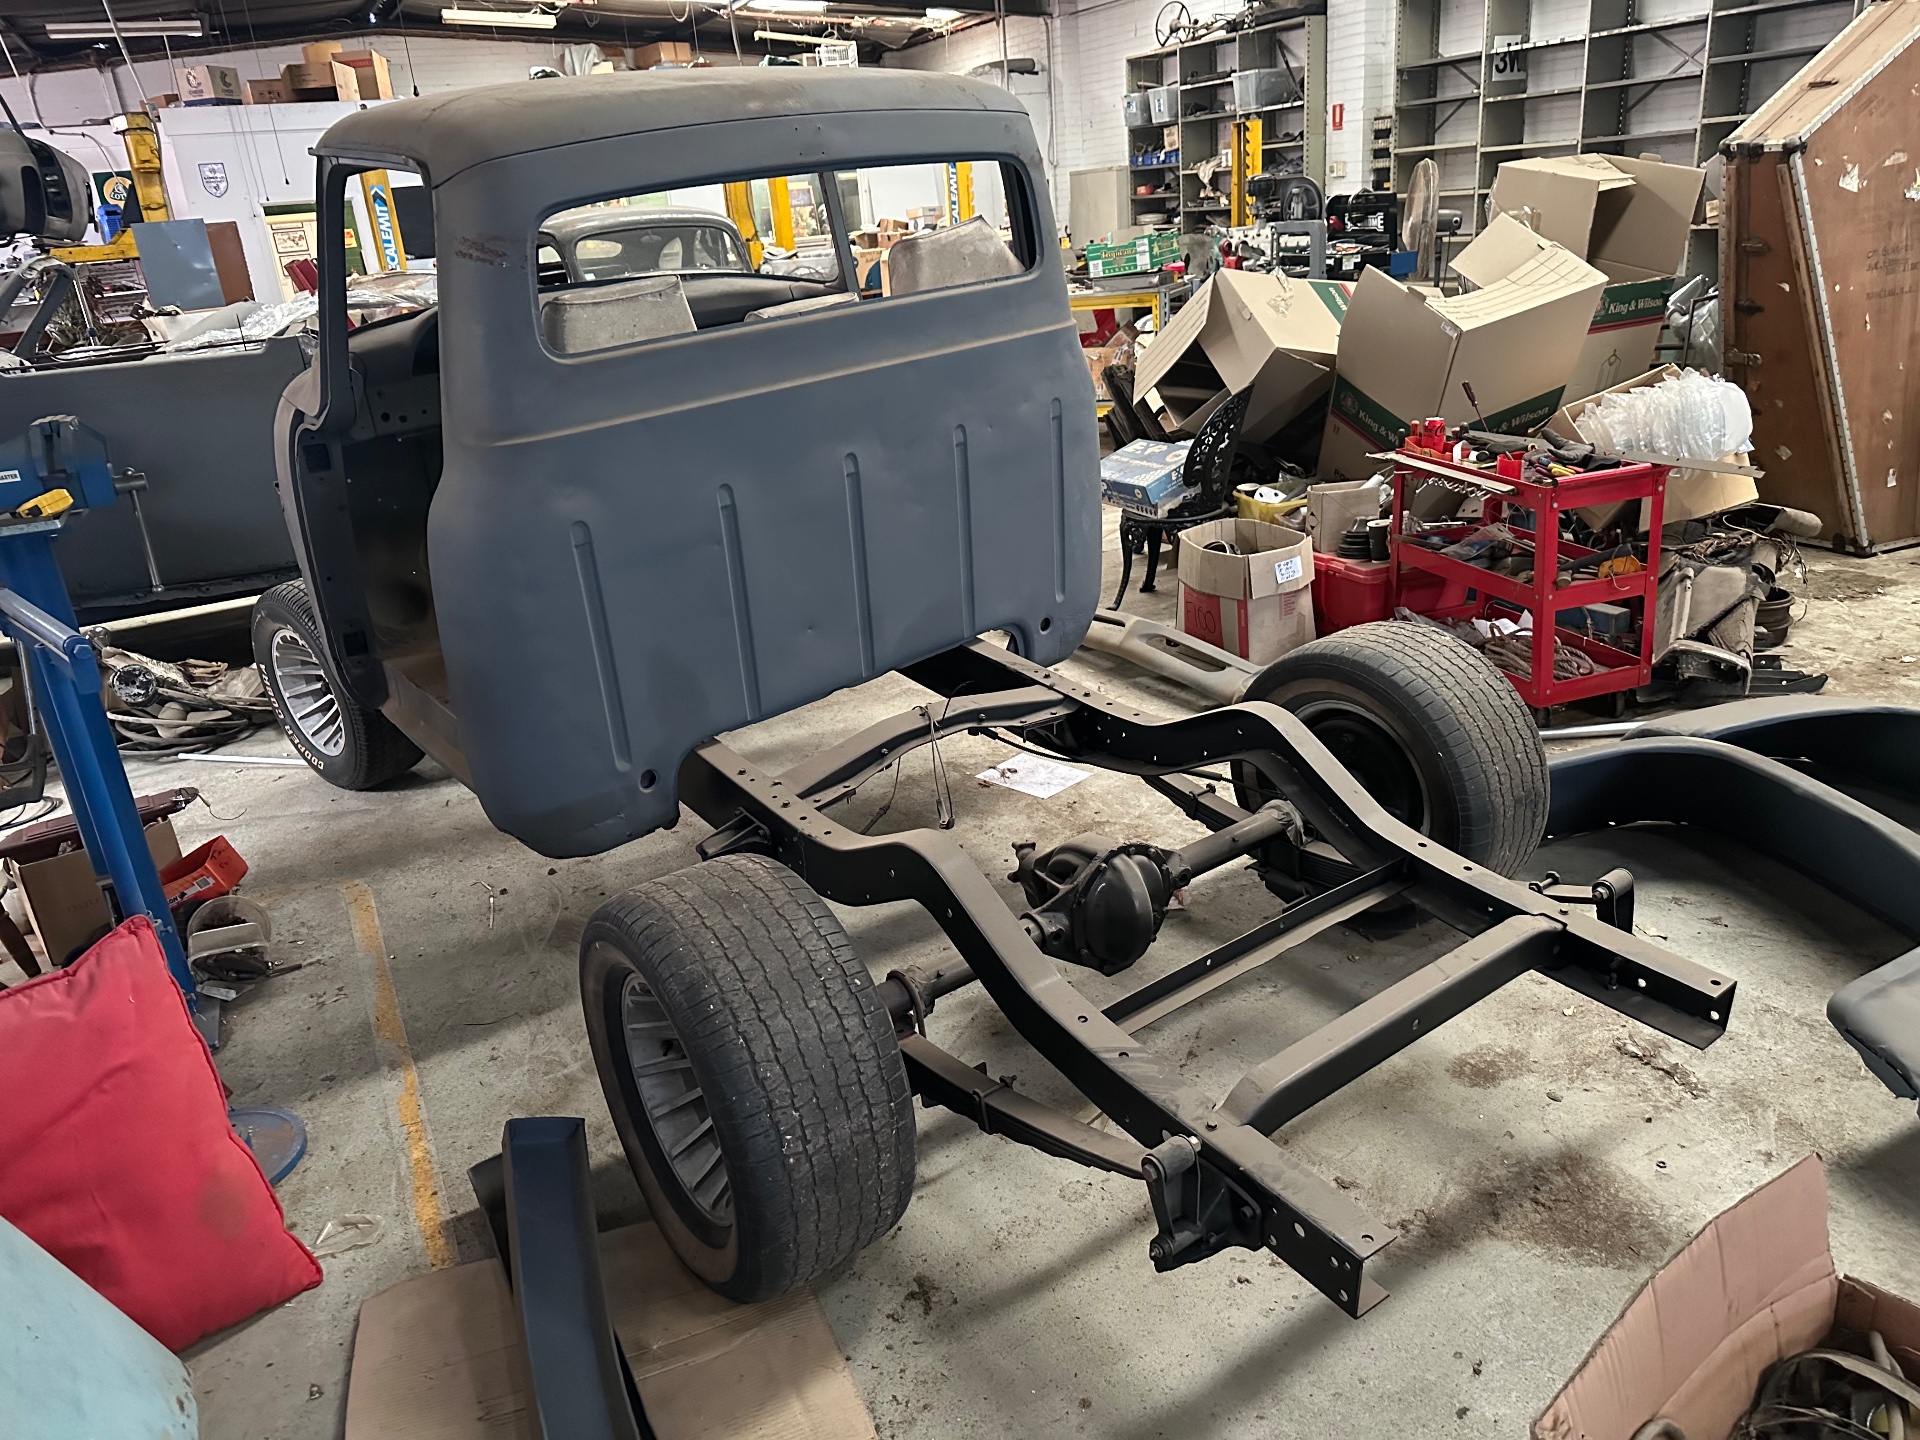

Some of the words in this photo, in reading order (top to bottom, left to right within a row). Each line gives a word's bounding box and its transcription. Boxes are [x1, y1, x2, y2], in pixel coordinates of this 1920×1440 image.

[110, 192, 127, 200] LOT
[948, 164, 959, 225] CALEMIT
[1105, 265, 1134, 274] BANANA
[1608, 302, 1629, 315] King
[1629, 300, 1637, 311] &
[1637, 297, 1663, 309] Wilson
[1359, 410, 1379, 432] King
[1379, 426, 1387, 437] &
[1511, 406, 1549, 428] Wilson
[0, 473, 18, 481] ASTER
[1185, 602, 1216, 634] F100
[259, 664, 285, 719] COBRA
[284, 725, 324, 770] COOPER
